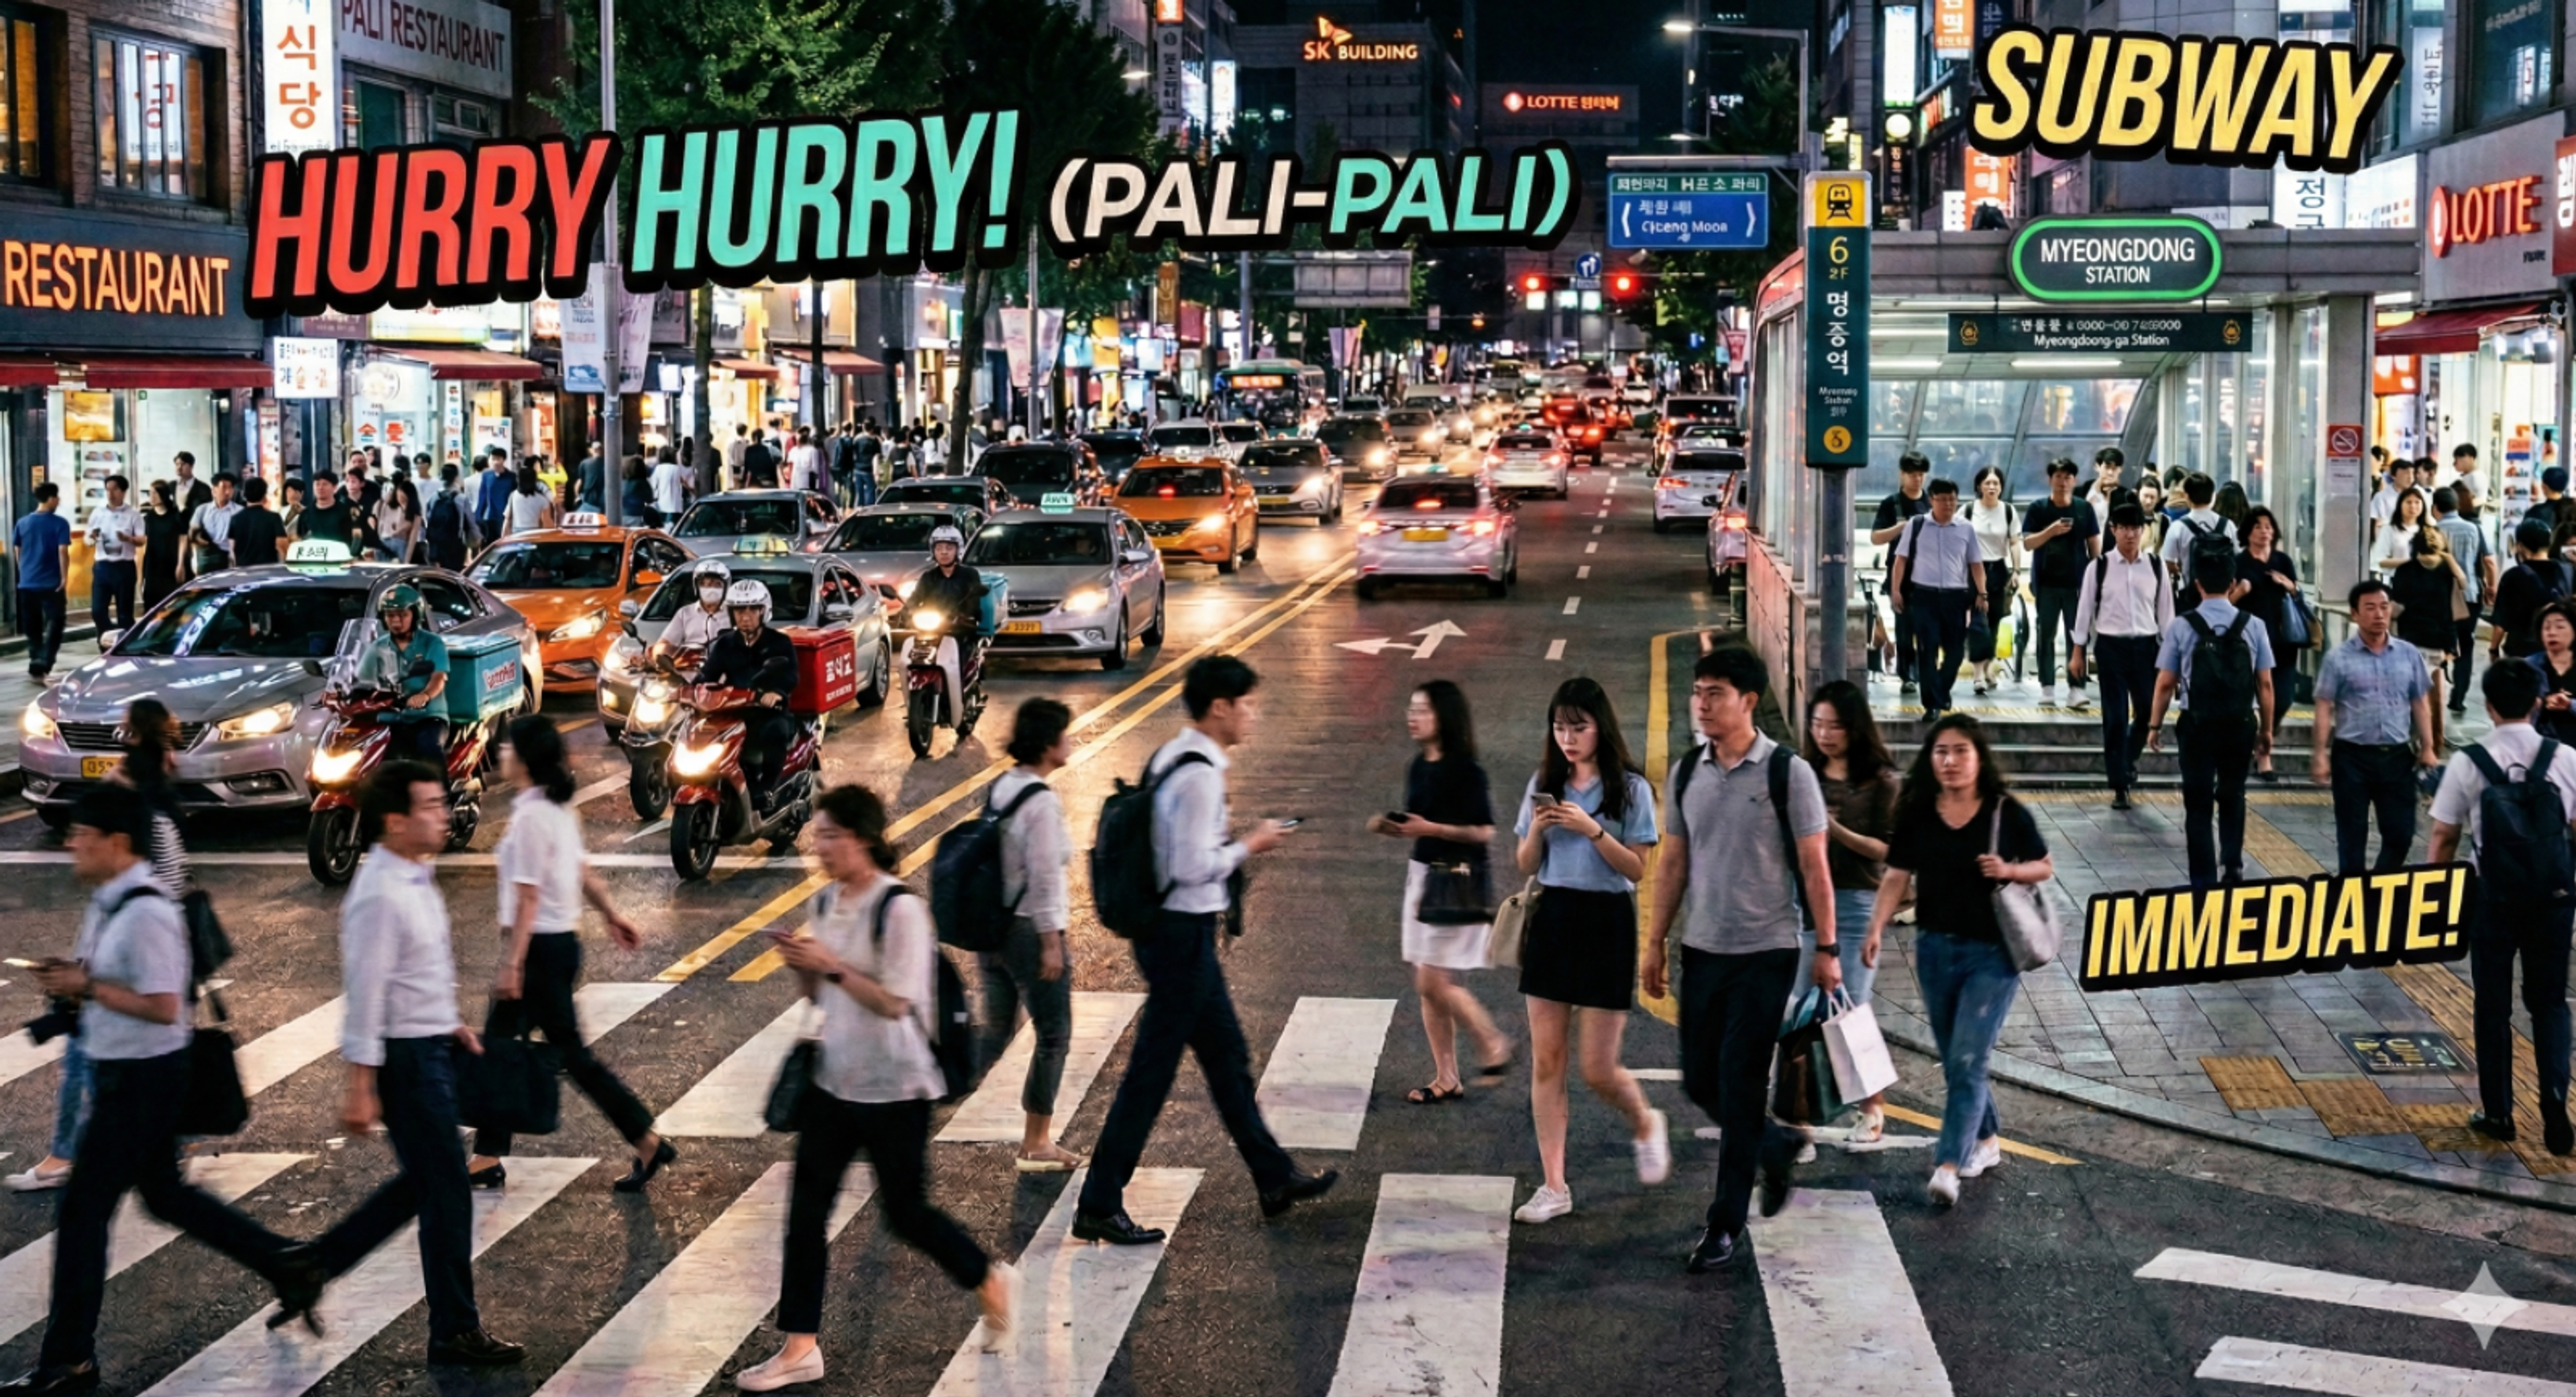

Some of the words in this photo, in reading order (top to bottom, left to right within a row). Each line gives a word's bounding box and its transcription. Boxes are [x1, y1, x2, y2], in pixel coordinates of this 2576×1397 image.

[341, 0, 384, 41] PALI
[390, 1, 506, 72] RESTAURANT
[1303, 40, 1331, 61] SK
[1338, 44, 1419, 60] BUILDING
[276, 0, 322, 130] 식당
[1527, 95, 1578, 109] LOTTE
[2451, 175, 2540, 244] LOTTE
[1829, 236, 1849, 264] 6
[2041, 237, 2196, 262] MYEONGDONG
[3, 239, 229, 317] RESTAURANT
[2085, 266, 2151, 284] STATION
[2131, 334, 2169, 346] Station
